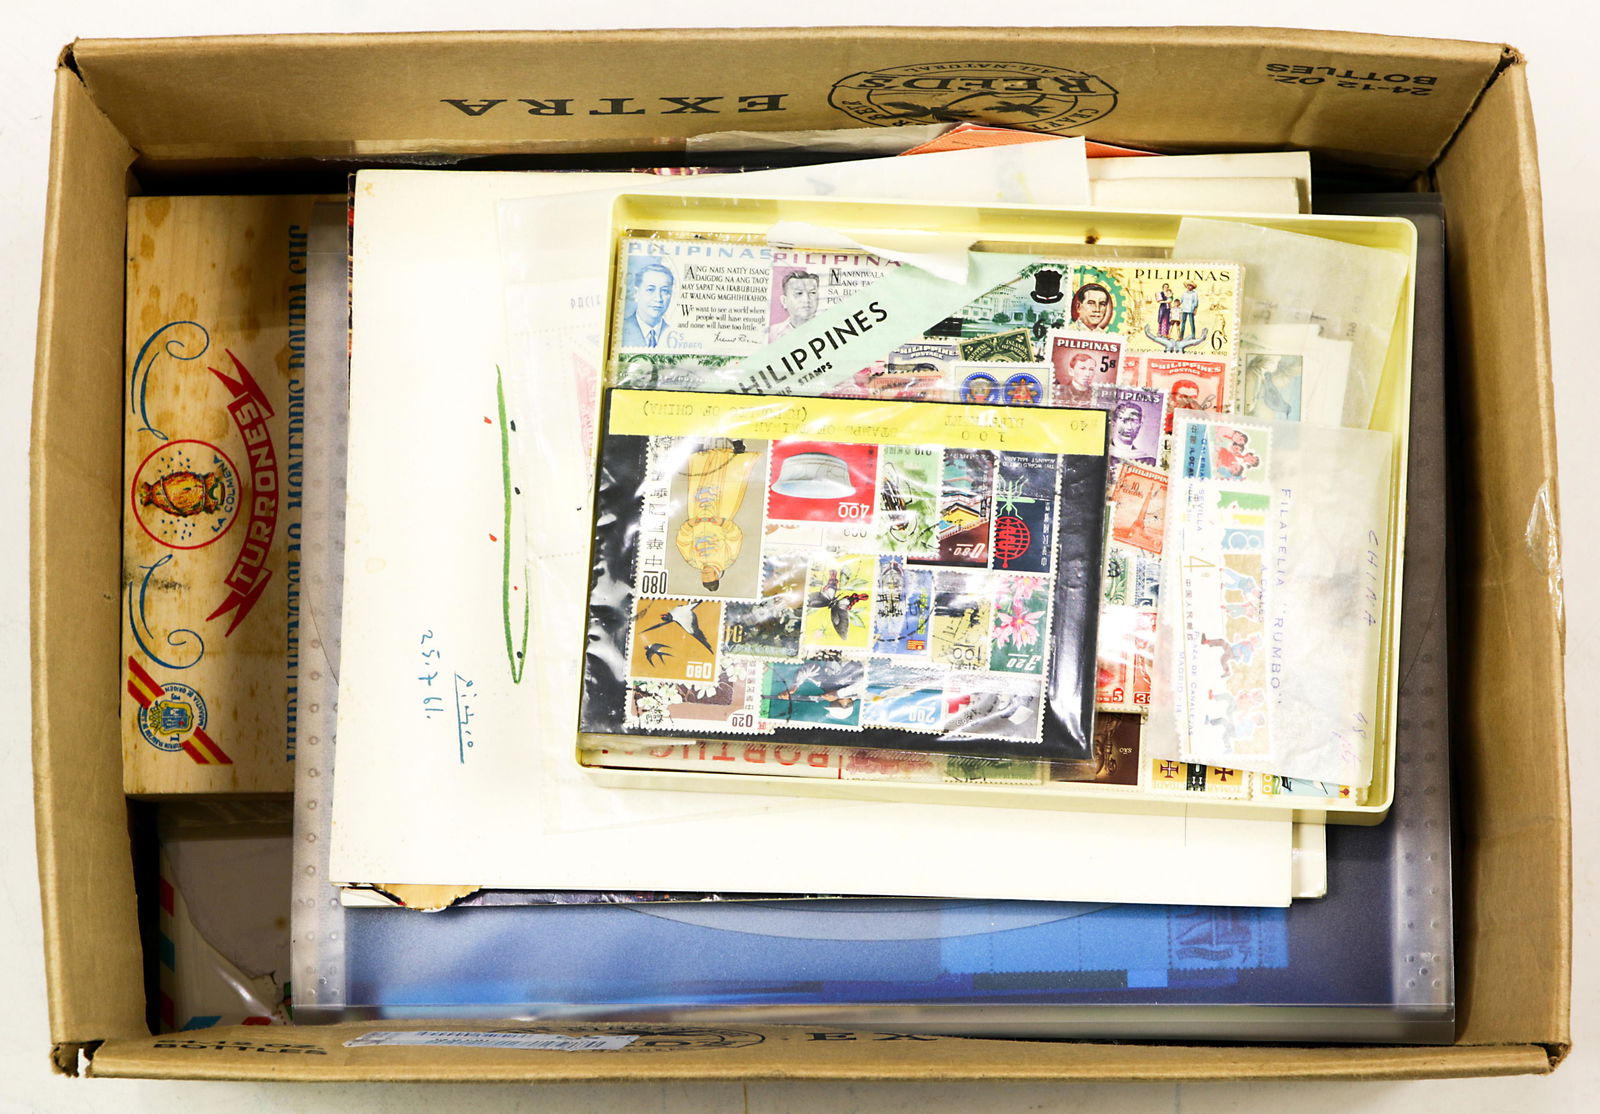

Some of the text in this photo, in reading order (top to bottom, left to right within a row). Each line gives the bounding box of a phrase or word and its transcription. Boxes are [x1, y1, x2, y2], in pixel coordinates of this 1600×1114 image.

[1266, 63, 1438, 86] BOTTLES
[857, 75, 1098, 95] REED'S
[440, 94, 789, 117] EXTRA
[628, 242, 773, 260] PILIPINAS
[773, 252, 902, 267] PILIPINA
[735, 275, 751, 284] ANG
[1134, 268, 1231, 282] PILIPINAS
[727, 301, 888, 396] HILIPPINES
[1056, 339, 1118, 353] PILIPINAS
[797, 361, 833, 385] STAMPS
[231, 402, 277, 584] TURRONES
[211, 517, 227, 532] LA
